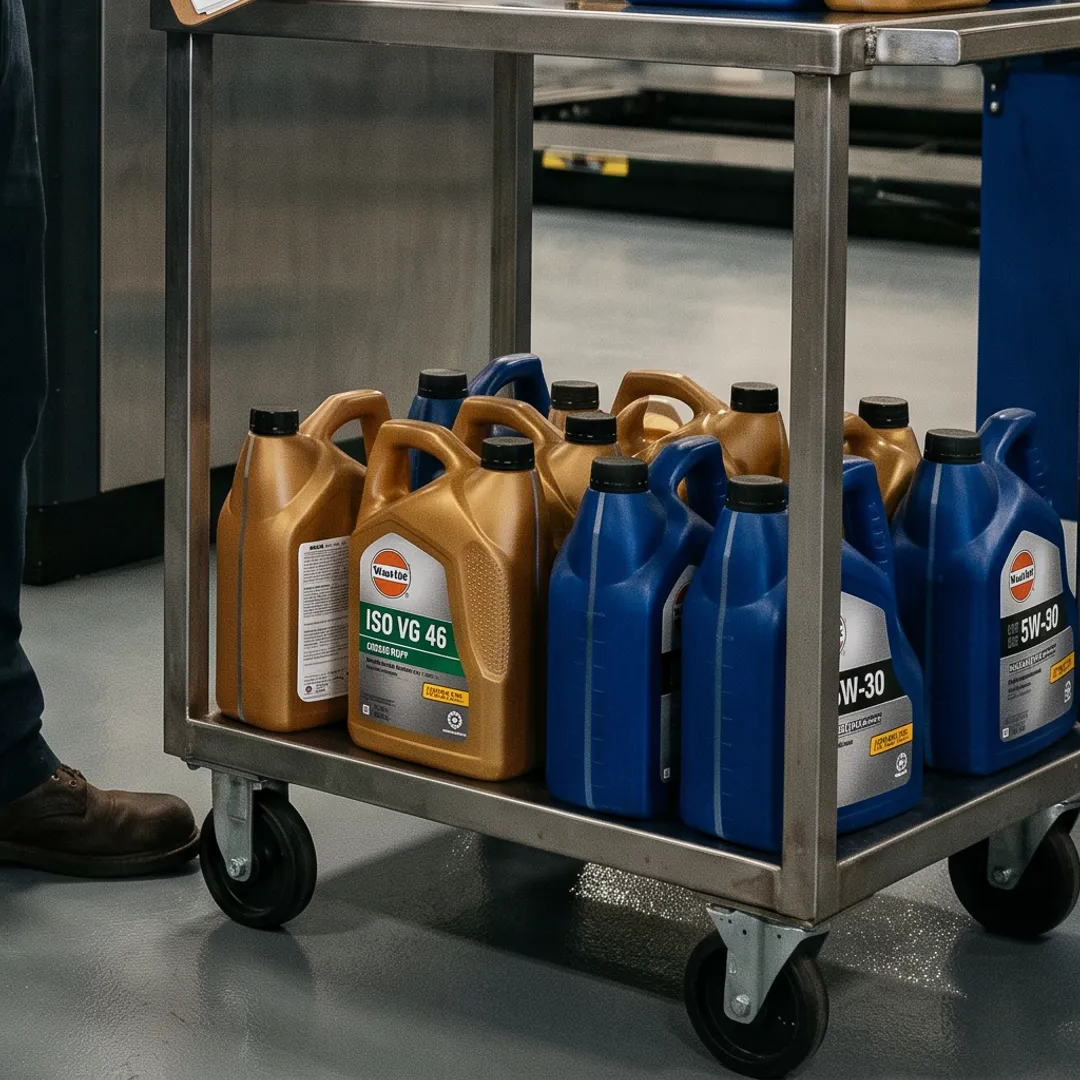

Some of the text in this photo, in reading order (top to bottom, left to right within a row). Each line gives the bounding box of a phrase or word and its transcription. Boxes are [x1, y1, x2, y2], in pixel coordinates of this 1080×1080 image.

[366, 608, 447, 649] ISO VG 46
[838, 669, 885, 706] W-30
